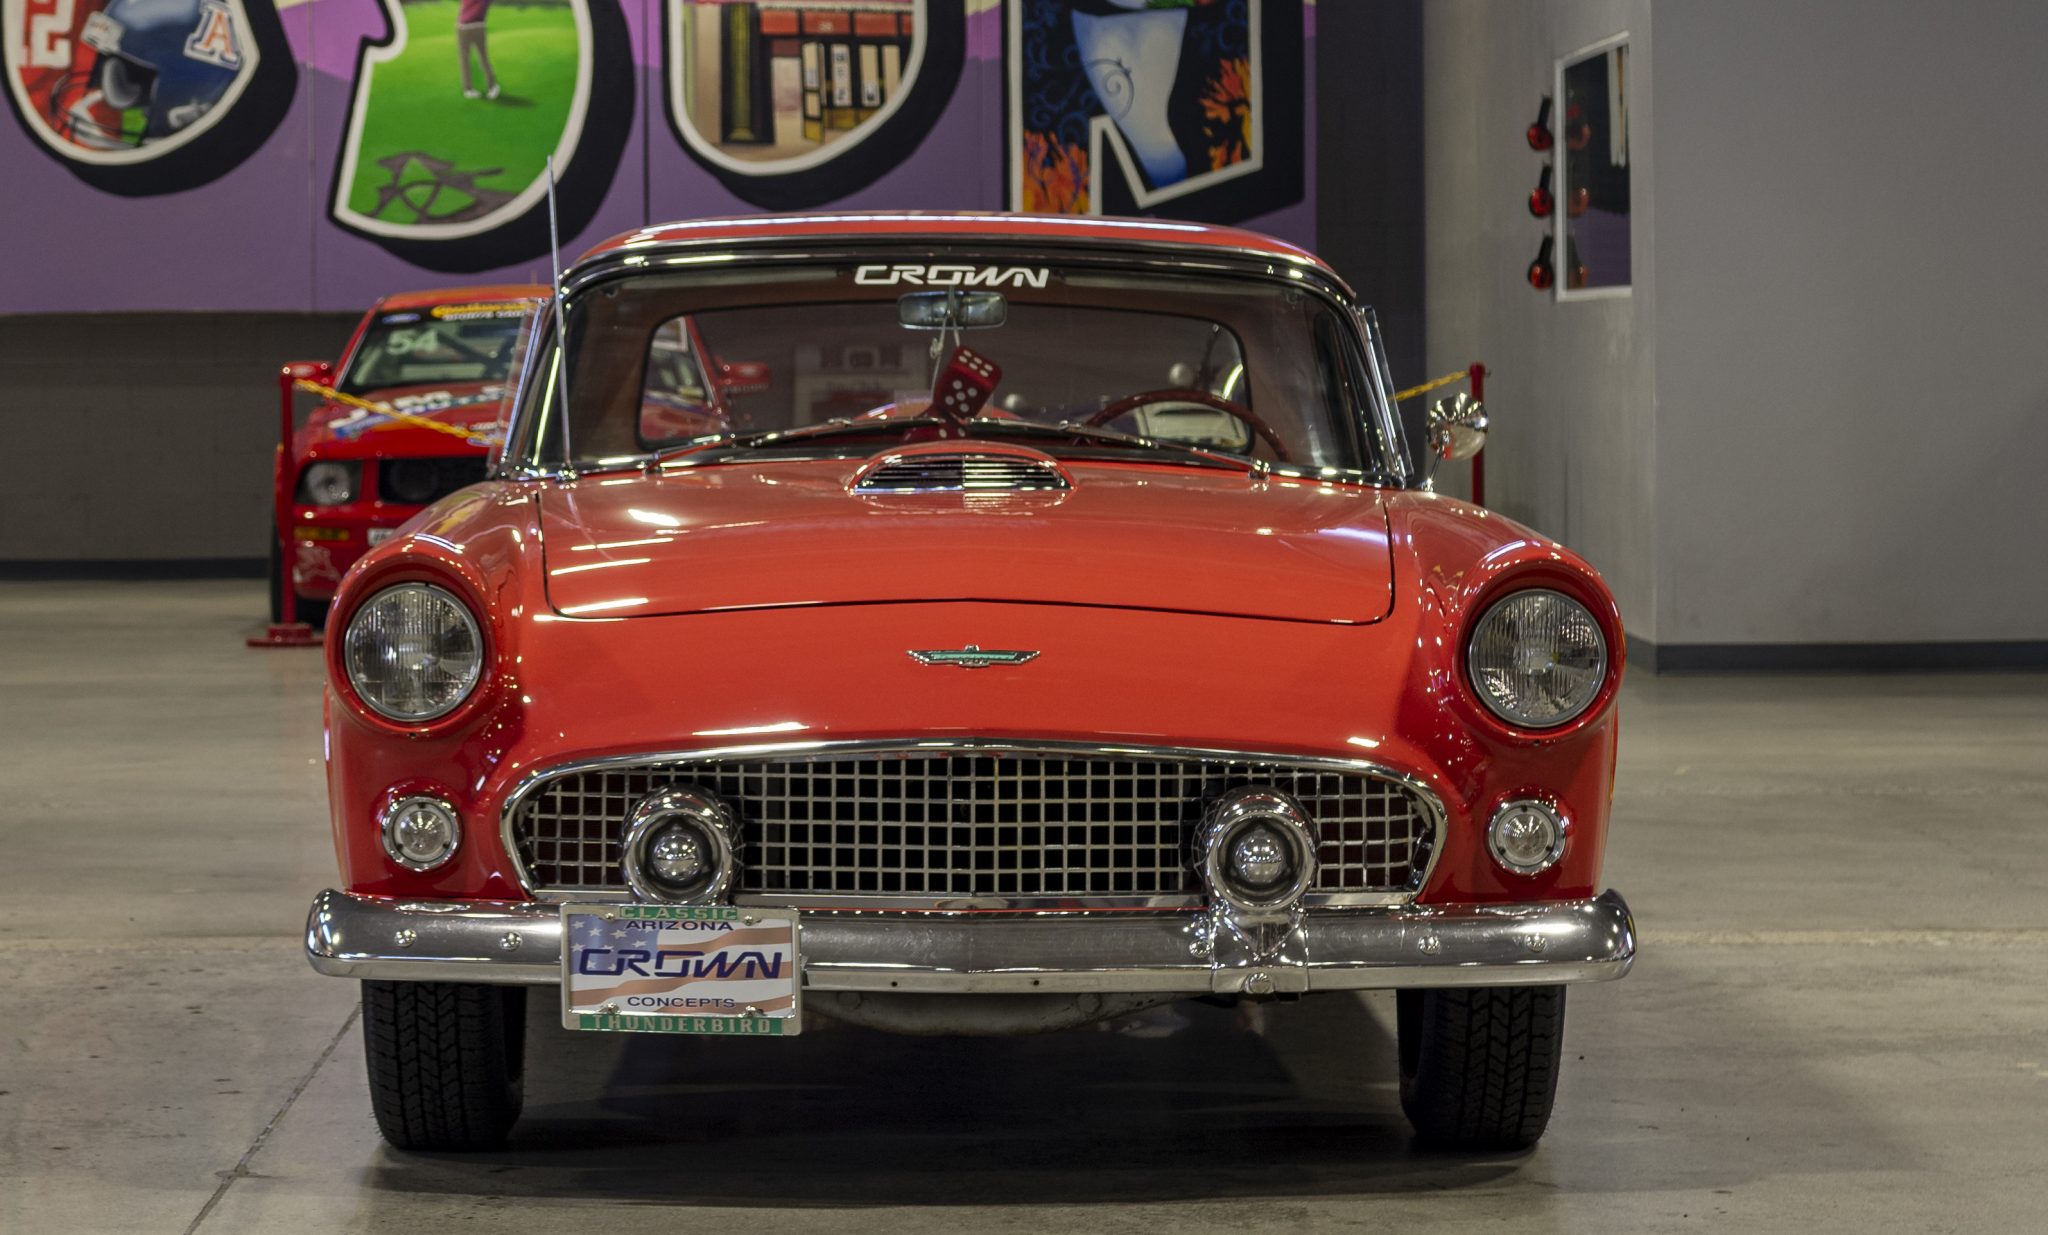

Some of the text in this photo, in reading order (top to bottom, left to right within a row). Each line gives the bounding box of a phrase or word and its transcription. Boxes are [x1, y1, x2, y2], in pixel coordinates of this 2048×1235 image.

[184, 2, 242, 70] A
[854, 265, 1050, 288] CROWN
[387, 329, 439, 355] 54
[621, 906, 738, 920] CLASSIC
[626, 920, 734, 931] ARIZONA
[579, 948, 783, 979] CROWN
[627, 996, 736, 1009] CONCEPTS
[591, 1014, 771, 1033] THUNDERBIRD
